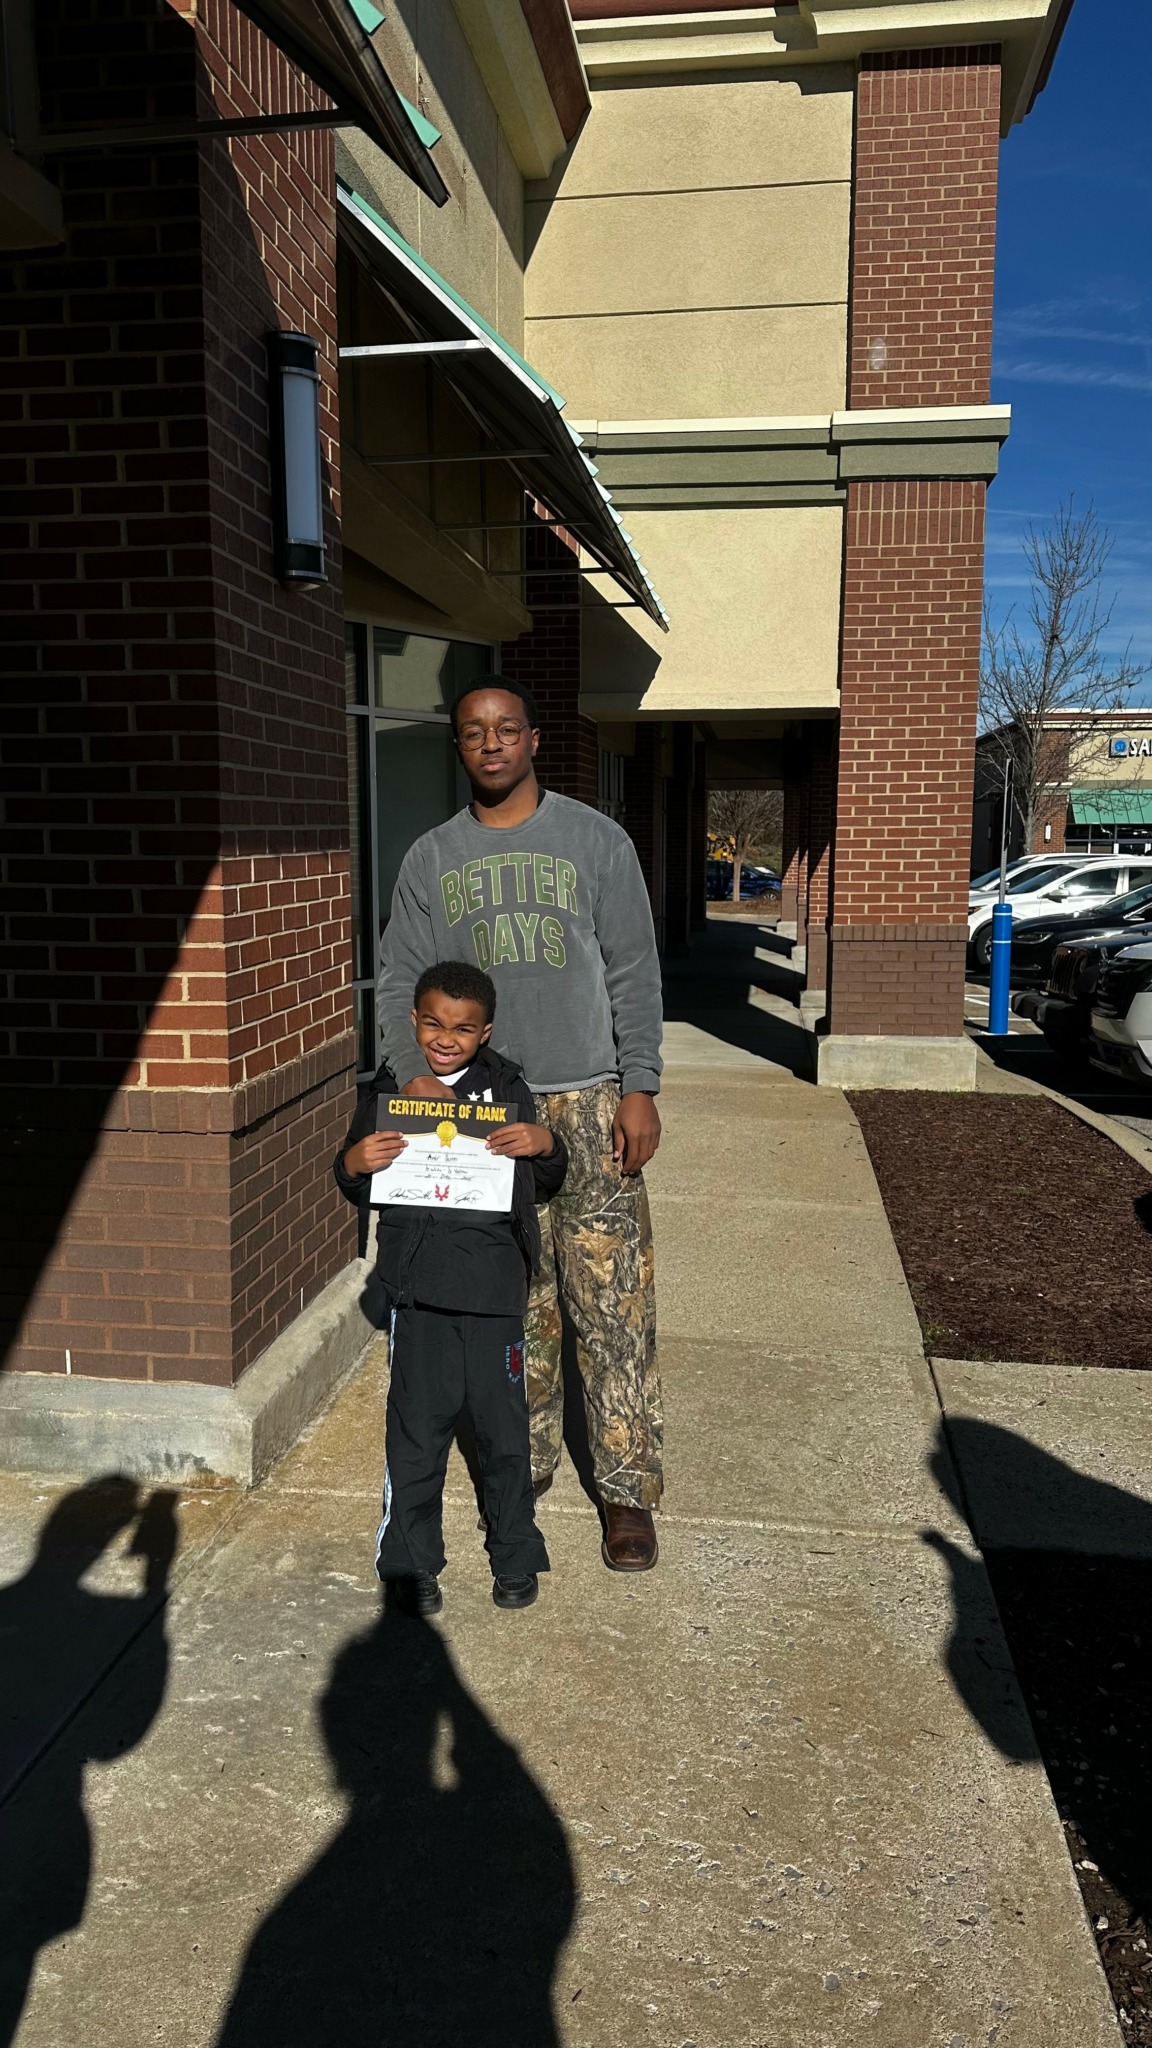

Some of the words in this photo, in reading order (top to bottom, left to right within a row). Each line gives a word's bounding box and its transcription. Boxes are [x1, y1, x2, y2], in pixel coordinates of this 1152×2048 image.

[1130, 738, 1152, 756] SA
[440, 853, 578, 927] BETTER
[471, 912, 567, 972] DAYS
[388, 1099, 455, 1118] CERTIFICATE
[458, 1104, 472, 1120] OF
[476, 1105, 507, 1122] RANK
